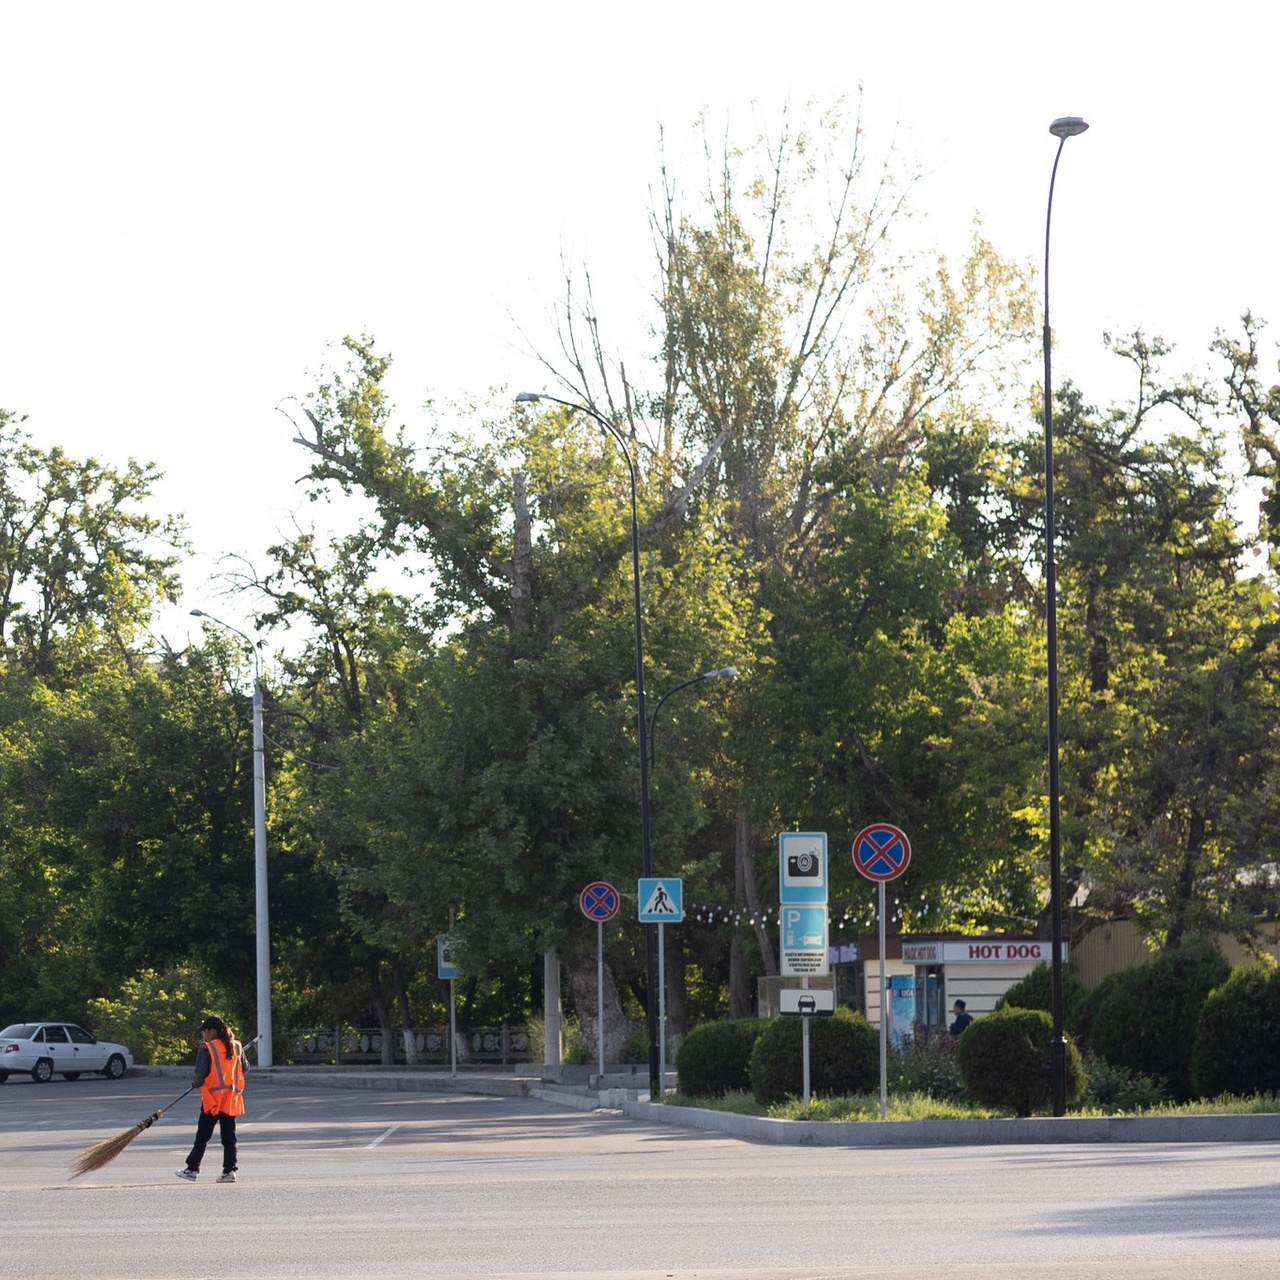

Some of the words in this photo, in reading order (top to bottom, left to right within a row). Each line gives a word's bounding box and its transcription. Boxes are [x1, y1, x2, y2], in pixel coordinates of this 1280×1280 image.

[788, 910, 801, 928] P
[969, 945, 1002, 958] HOT
[1007, 945, 1041, 958] DOG
